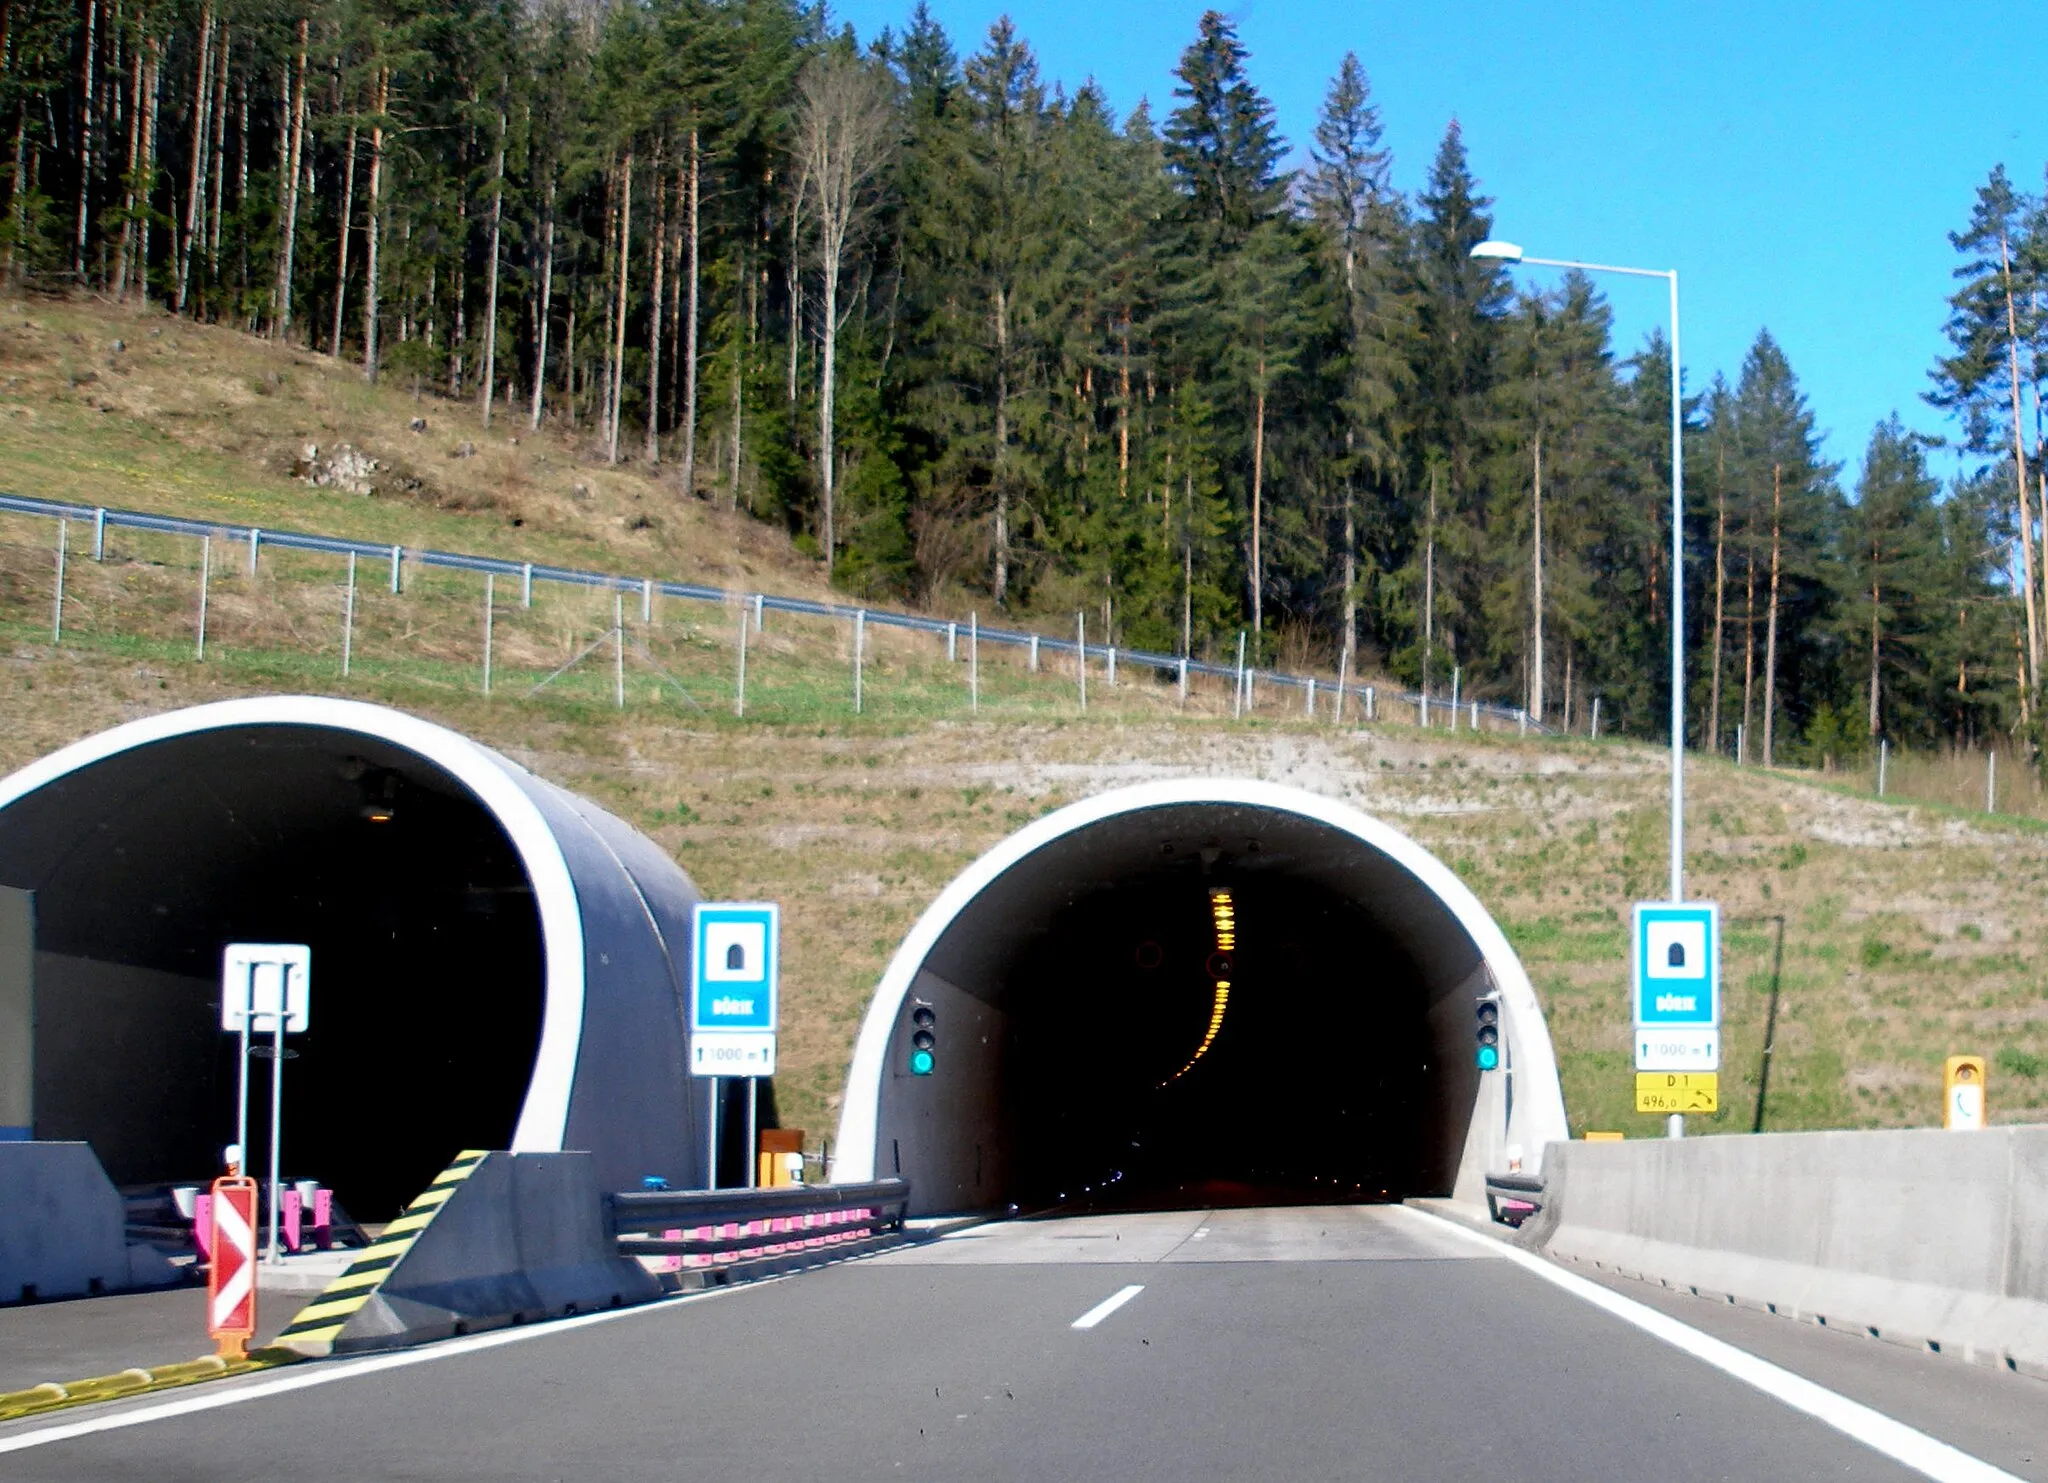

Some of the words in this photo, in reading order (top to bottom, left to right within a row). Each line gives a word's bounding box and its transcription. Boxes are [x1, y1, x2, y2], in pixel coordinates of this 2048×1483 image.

[710, 1047, 742, 1060] 1000
[1654, 1044, 1686, 1056] 1000
[1667, 1075, 1676, 1087] D
